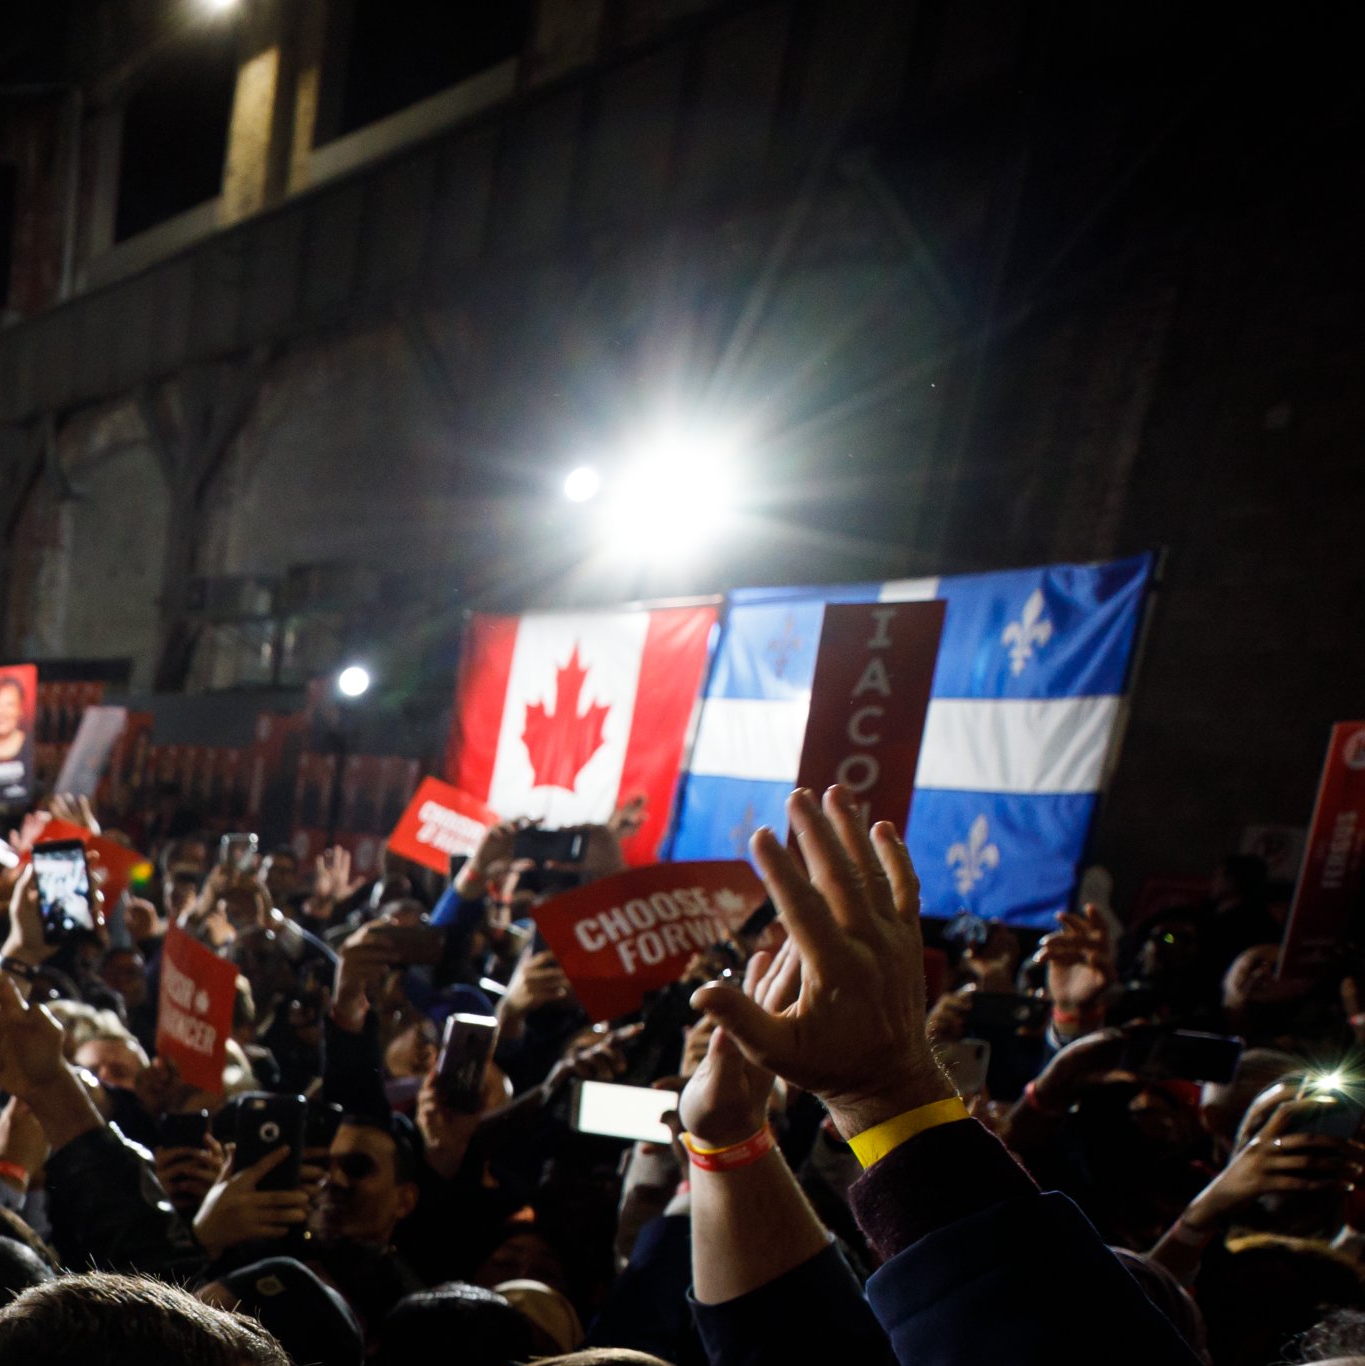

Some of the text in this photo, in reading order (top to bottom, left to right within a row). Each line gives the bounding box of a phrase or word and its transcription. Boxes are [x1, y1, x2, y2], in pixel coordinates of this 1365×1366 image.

[836, 607, 898, 829] IACO
[573, 886, 718, 953] CHOOSE
[615, 917, 730, 975] FORW
